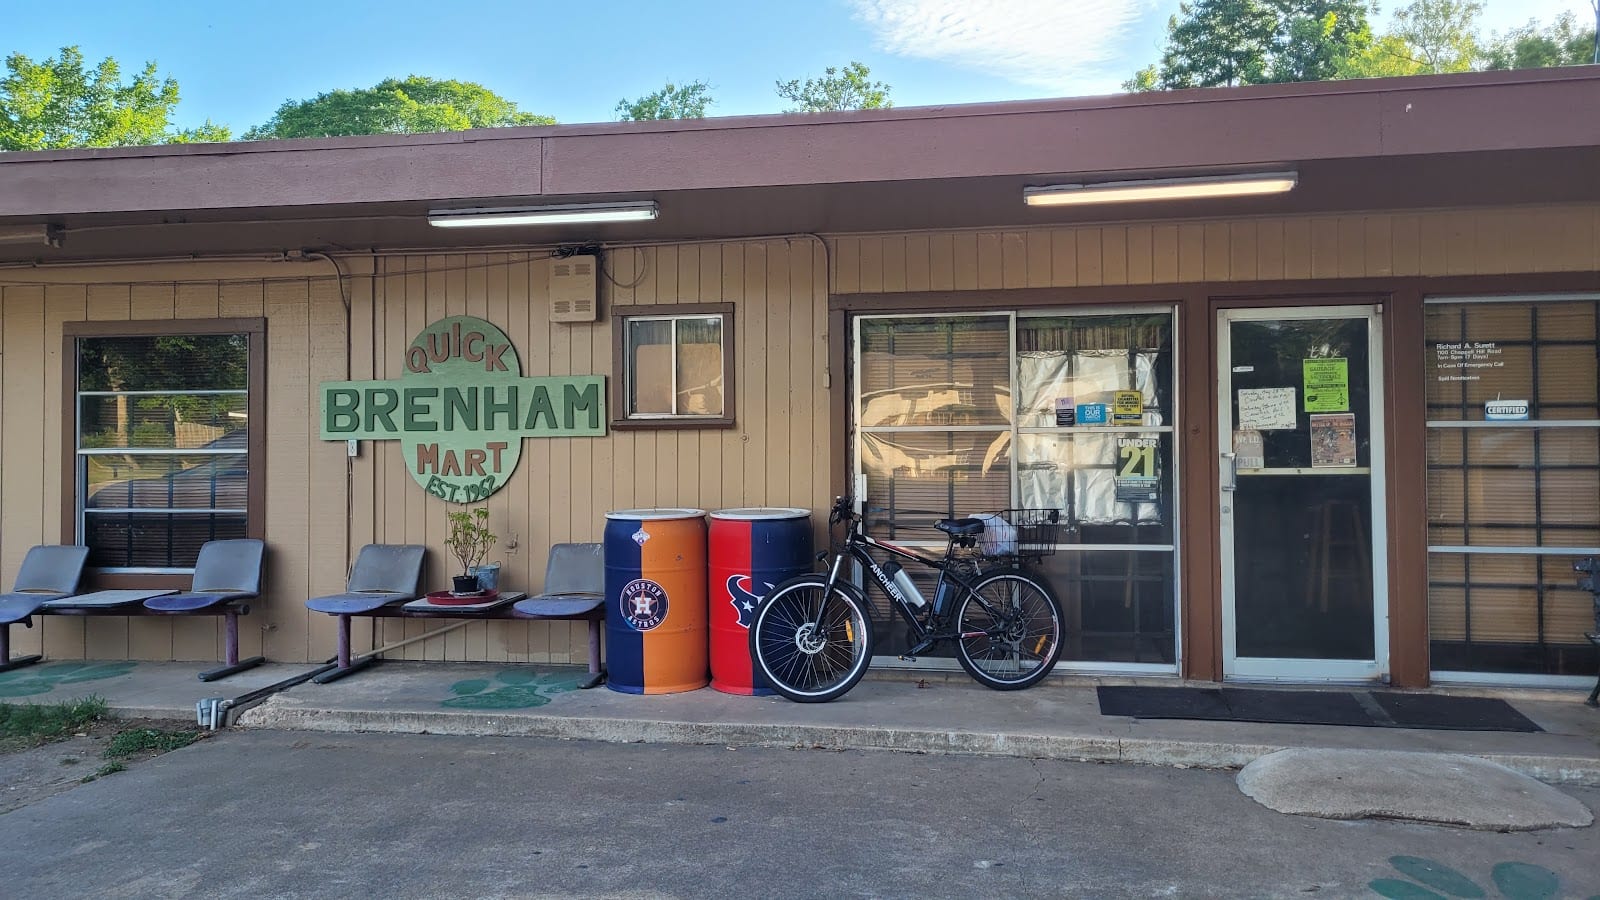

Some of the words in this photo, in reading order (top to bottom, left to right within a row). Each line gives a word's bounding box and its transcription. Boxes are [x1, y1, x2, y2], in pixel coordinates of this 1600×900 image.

[406, 322, 510, 374] QUICK
[326, 383, 598, 432] BRENHAM
[1118, 439, 1156, 448] UNDER
[416, 442, 508, 476] MART
[1120, 447, 1155, 478] 21
[1237, 457, 1258, 467] PULL
[426, 475, 462, 503] EST.
[465, 475, 500, 502] 1962
[626, 582, 662, 597] HOUSTON
[870, 564, 902, 602] ANCHEER
[634, 597, 652, 614] H
[627, 615, 660, 628] ASTROS
